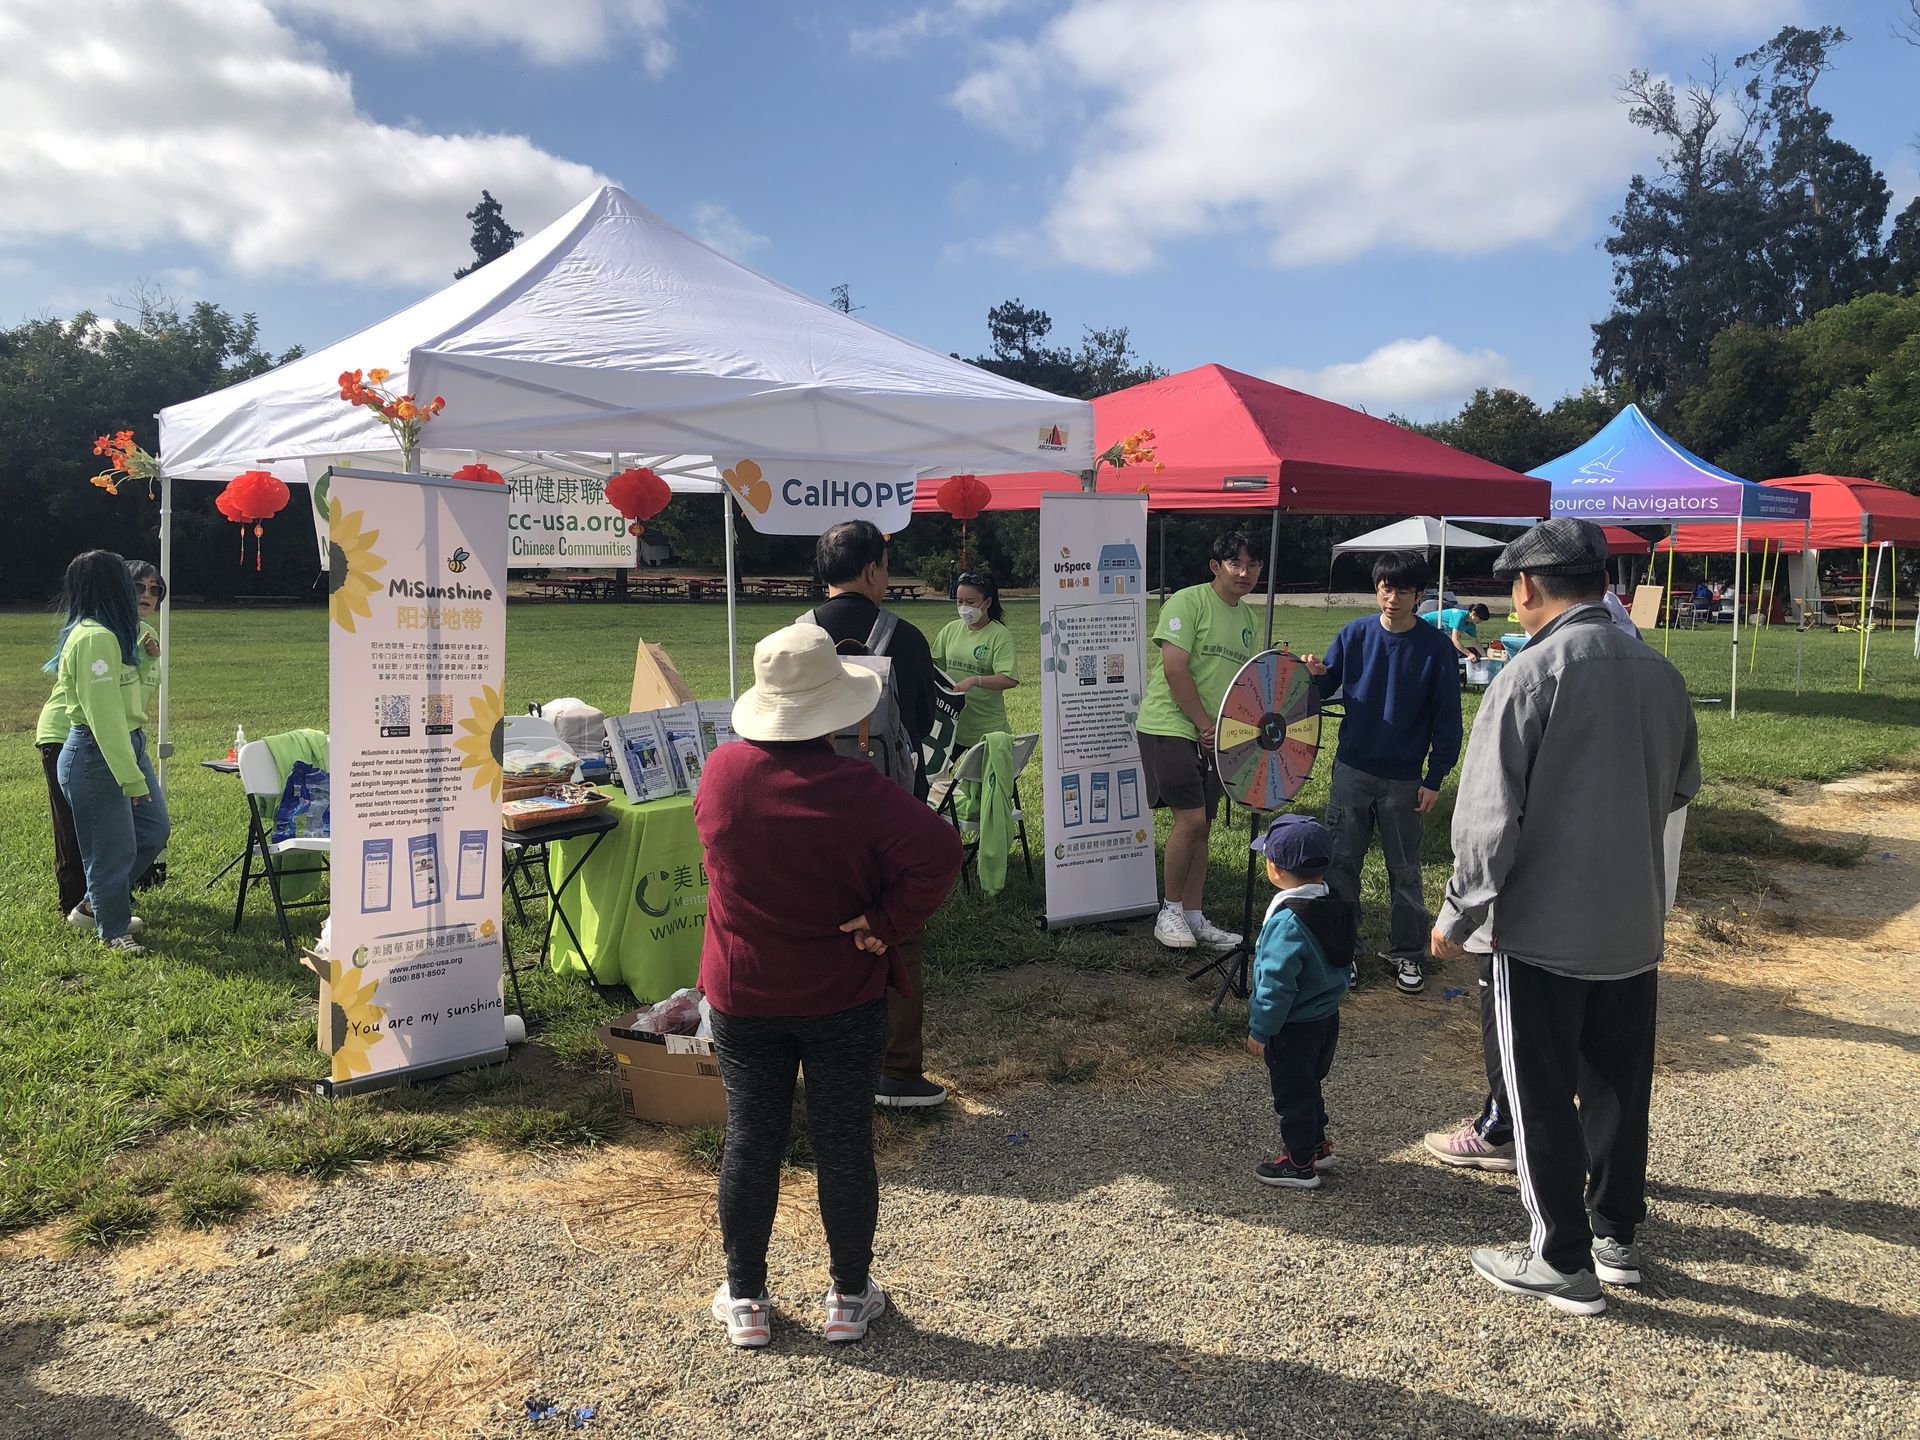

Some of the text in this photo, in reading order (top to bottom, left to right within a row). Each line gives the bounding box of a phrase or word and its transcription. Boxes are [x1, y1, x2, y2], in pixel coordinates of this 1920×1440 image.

[1571, 477, 1616, 485] FRN
[782, 478, 915, 508] CalHOPE
[1550, 495, 1719, 513] source Navigators
[509, 512, 626, 538] cc-usa.org
[512, 536, 631, 556] Chinese Communities
[1054, 562, 1091, 574] UrSpace
[388, 578, 493, 601] MiSunshine
[396, 605, 482, 630] 阳光地带
[1226, 729, 1236, 738] Ball
[650, 912, 707, 940] www.m
[372, 932, 476, 957] 美國華裔精神健康聯盟
[389, 956, 463, 975] www.mhacc-usa.org
[389, 968, 446, 985] (800) 881-8502
[351, 997, 502, 1037] You are my sunshine
